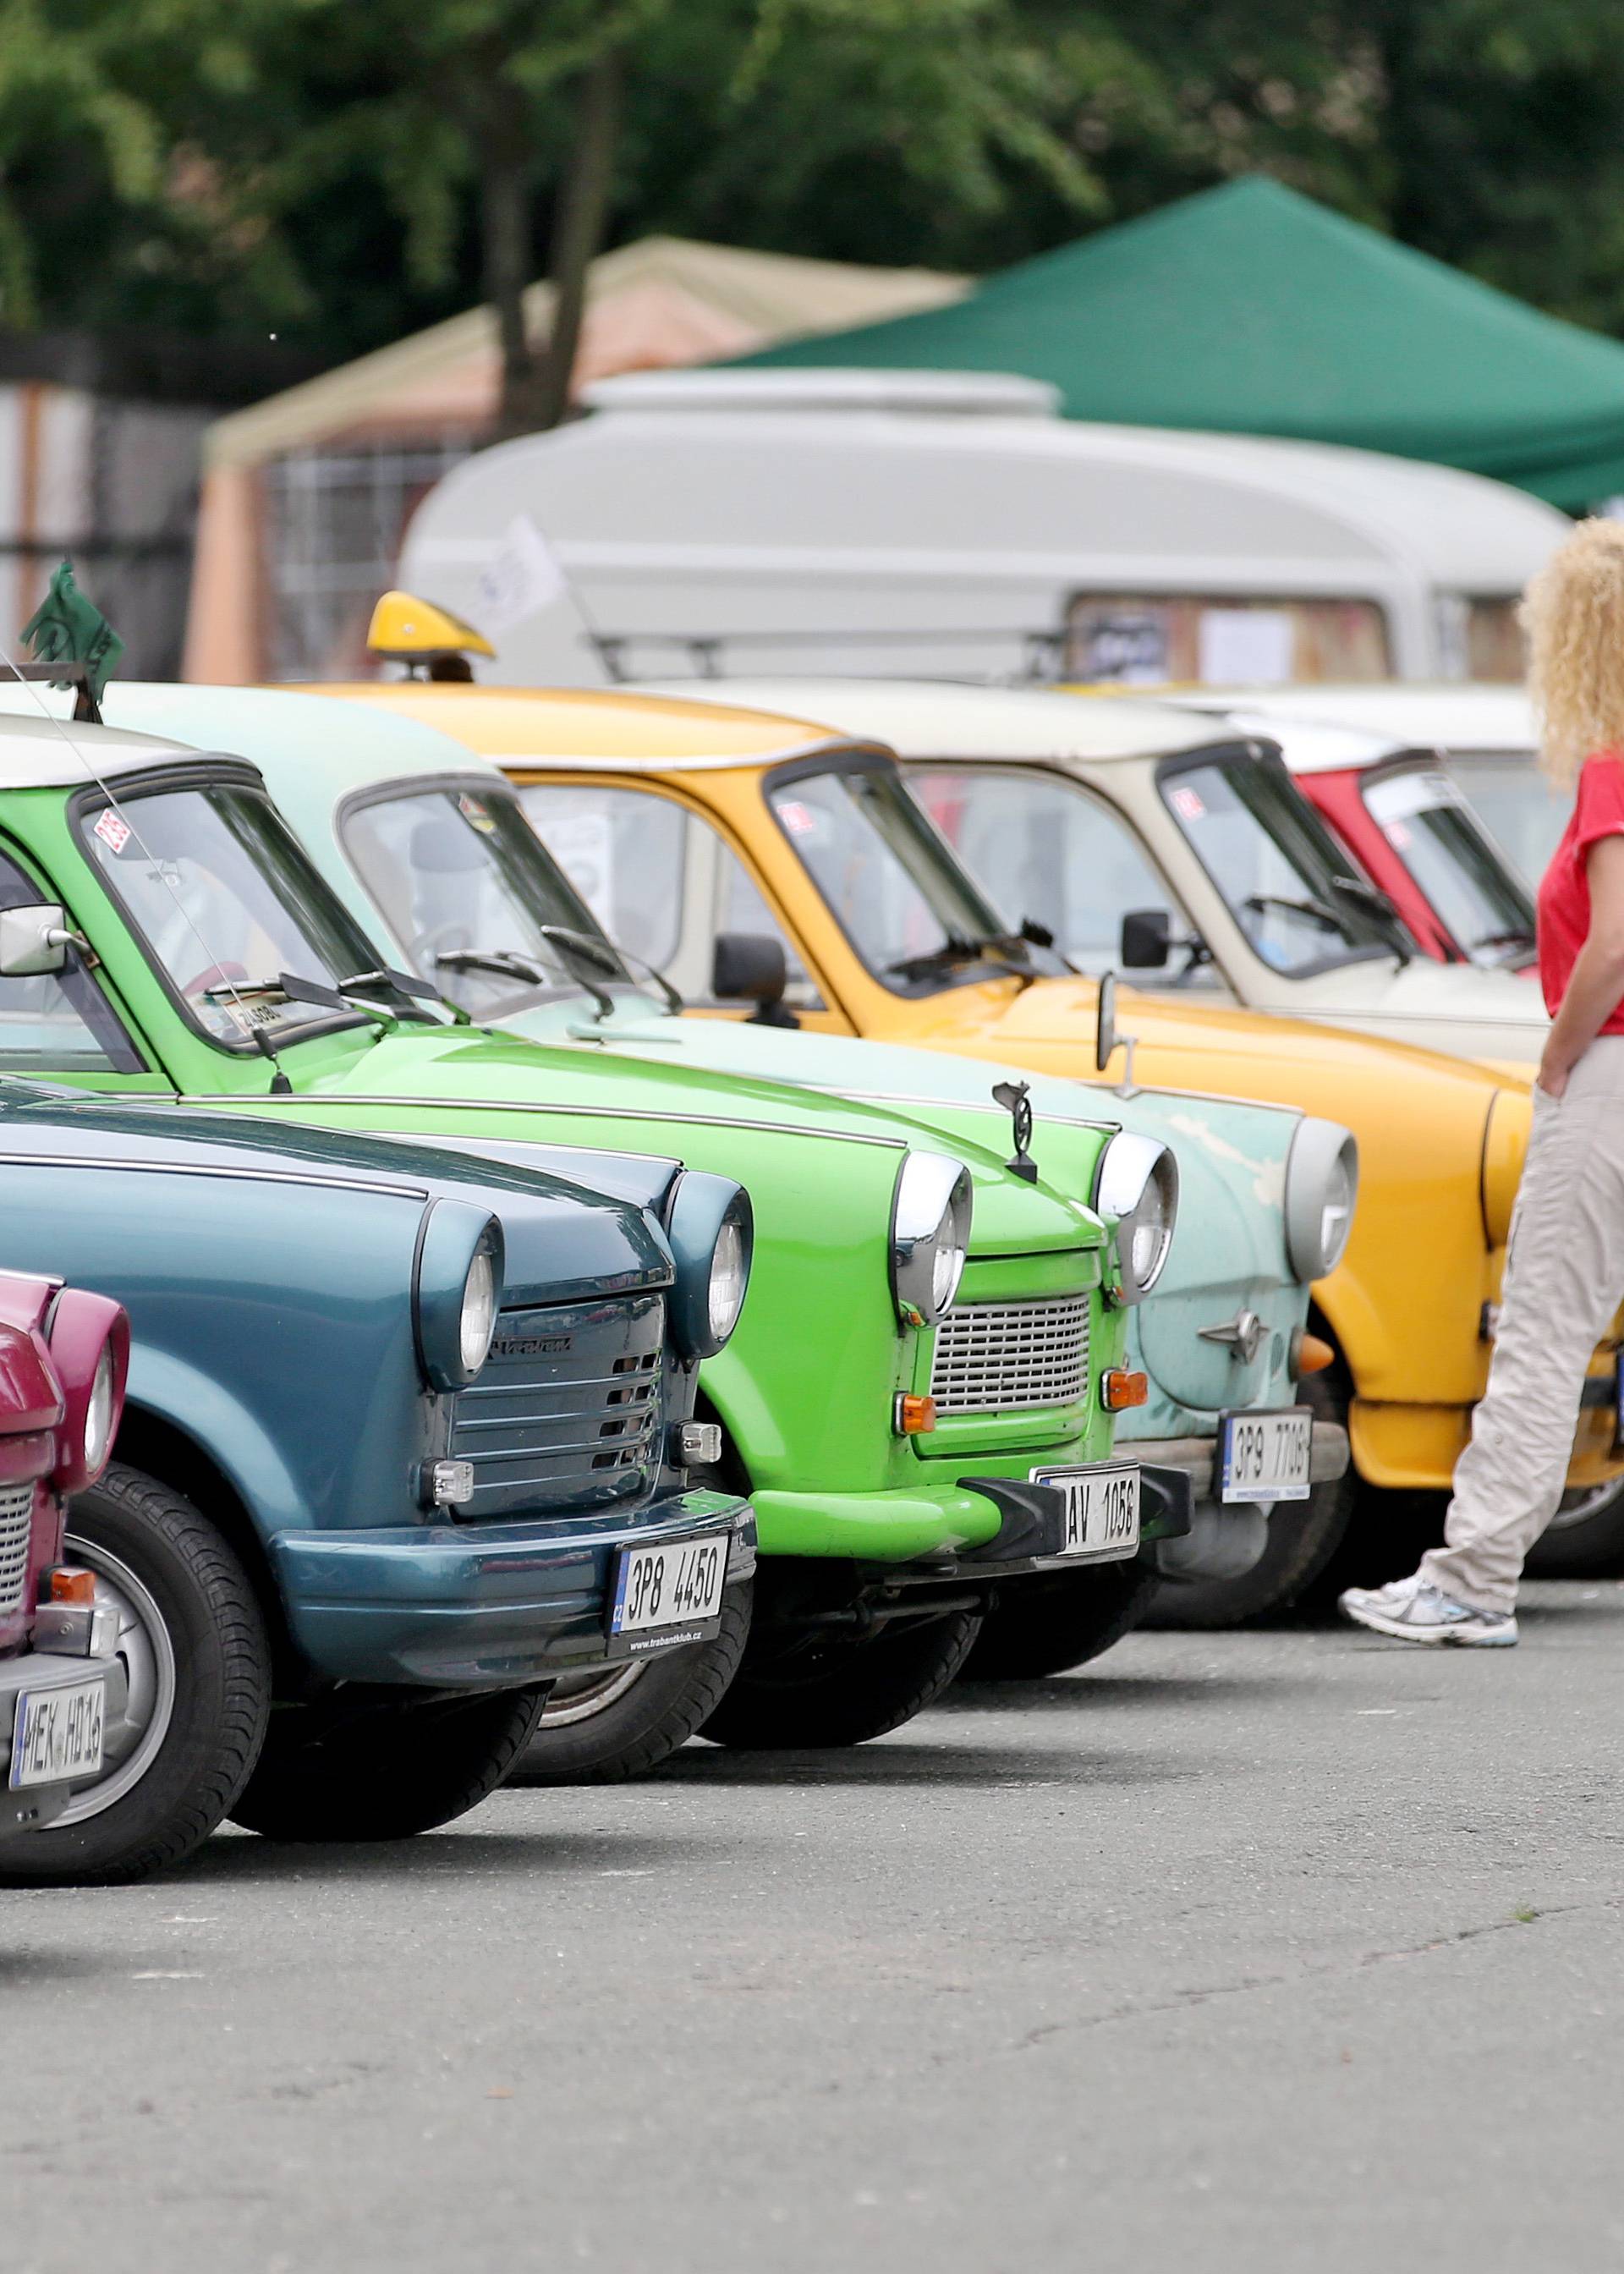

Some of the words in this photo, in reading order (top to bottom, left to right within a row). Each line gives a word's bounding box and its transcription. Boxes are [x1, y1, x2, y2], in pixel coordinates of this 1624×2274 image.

[1235, 1425, 1265, 1480] 3P9
[1102, 1479, 1134, 1541] 1056
[628, 1555, 665, 1620] 3P8
[673, 1546, 718, 1613] 4450
[612, 1604, 623, 1623] CZ
[630, 1631, 702, 1651] www.trabantklub.cz
